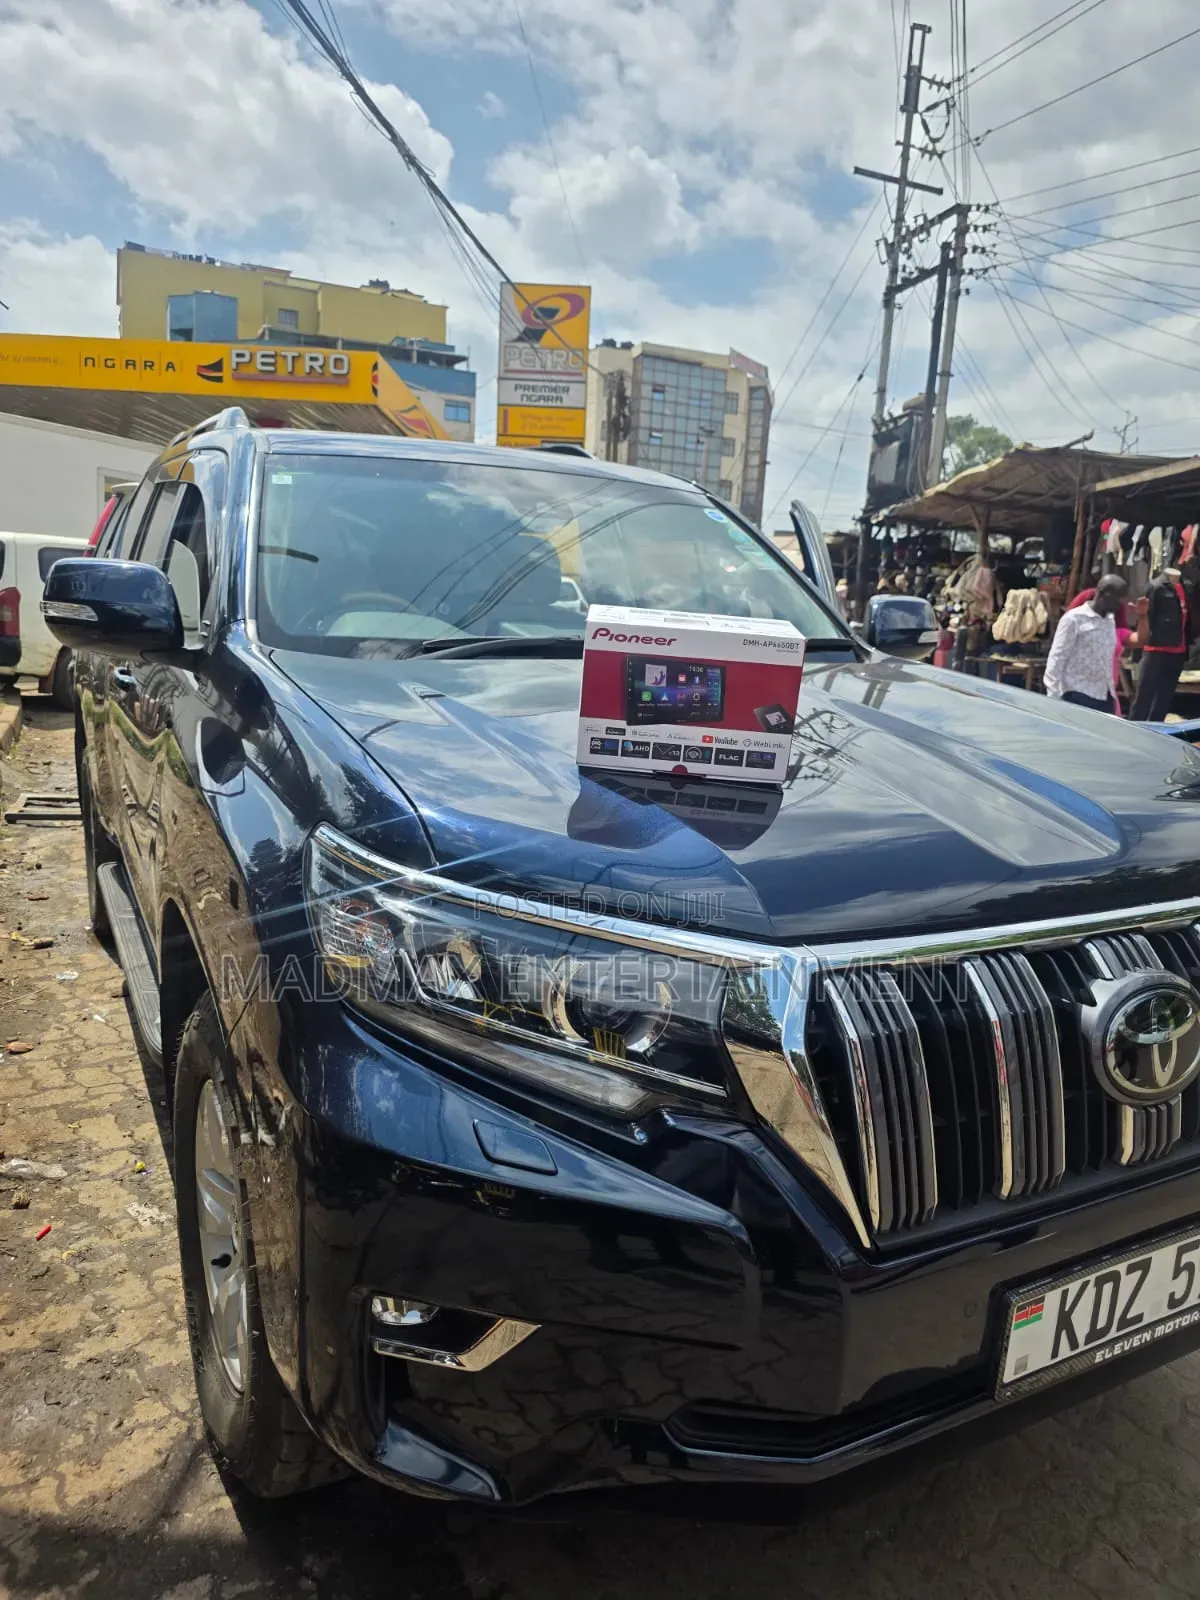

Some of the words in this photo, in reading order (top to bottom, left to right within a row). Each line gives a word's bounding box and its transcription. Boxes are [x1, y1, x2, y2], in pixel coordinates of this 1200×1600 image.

[84, 356, 176, 372] NGARA
[231, 349, 350, 376] PETRO
[504, 346, 583, 369] PETRO
[514, 383, 571, 395] PREMIER
[520, 393, 564, 404] NGARA
[591, 627, 678, 647] Pioneer
[634, 744, 650, 752] AHD
[714, 735, 738, 746] YouTube
[718, 753, 739, 761] FLAC
[1050, 1256, 1152, 1361] KDZ
[1167, 1238, 1200, 1310] 5
[1094, 1331, 1152, 1364] ELEVEN
